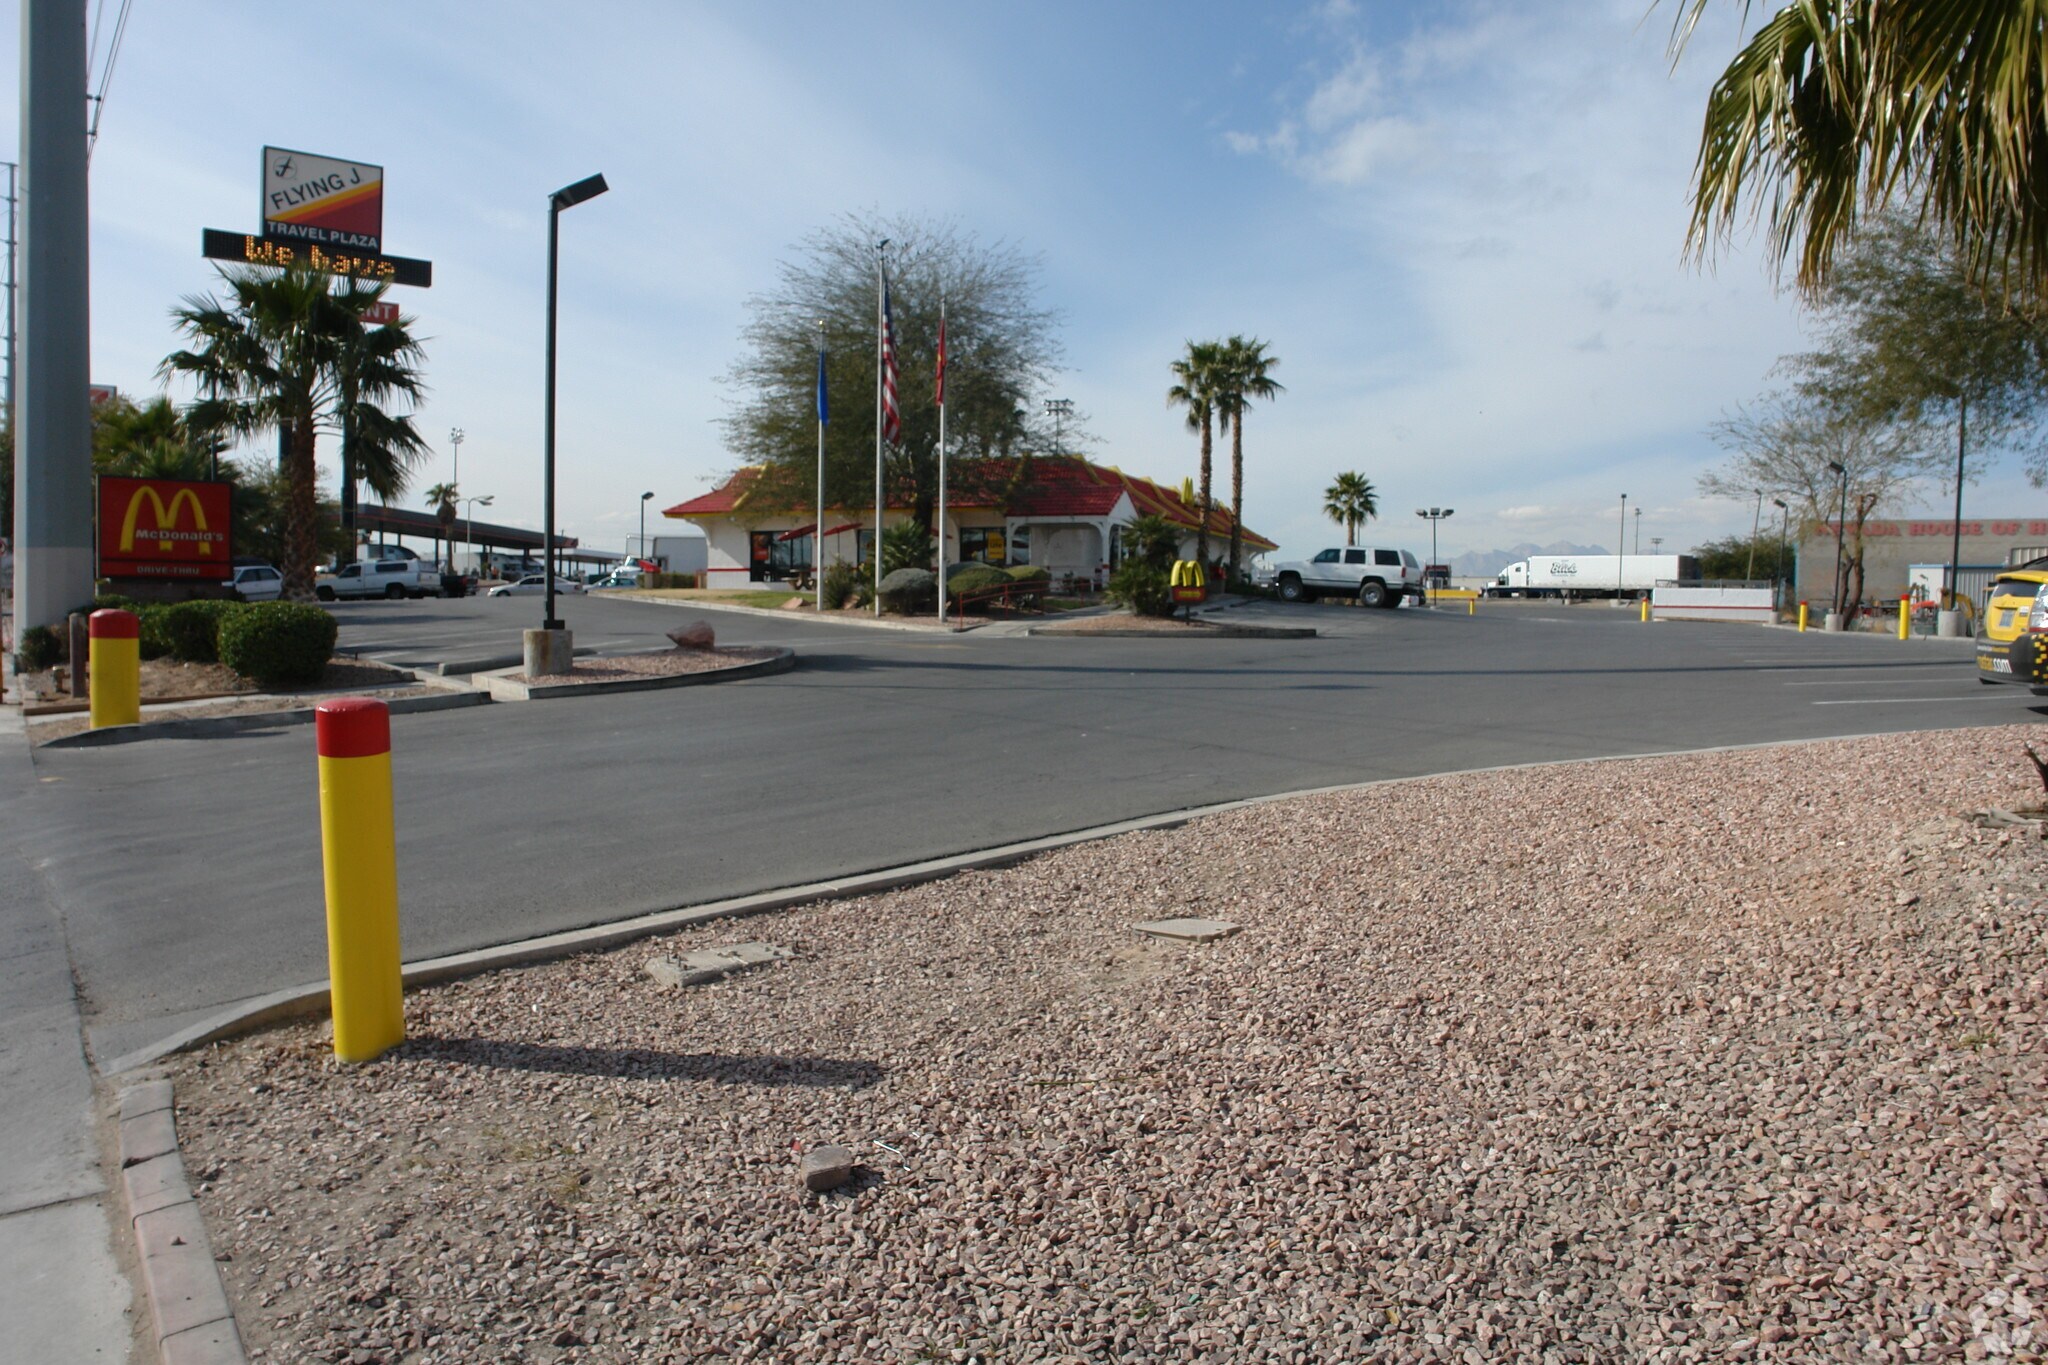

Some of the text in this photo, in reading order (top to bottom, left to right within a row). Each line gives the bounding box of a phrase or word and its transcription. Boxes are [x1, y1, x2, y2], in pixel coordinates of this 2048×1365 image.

[270, 167, 362, 210] FLYING J
[267, 220, 379, 249] TRAVEL PLAZA
[245, 234, 396, 276] We have
[135, 529, 224, 542] McDonald's
[1990, 522, 2022, 537] OF
[136, 565, 201, 576] DRIVE-THRU
